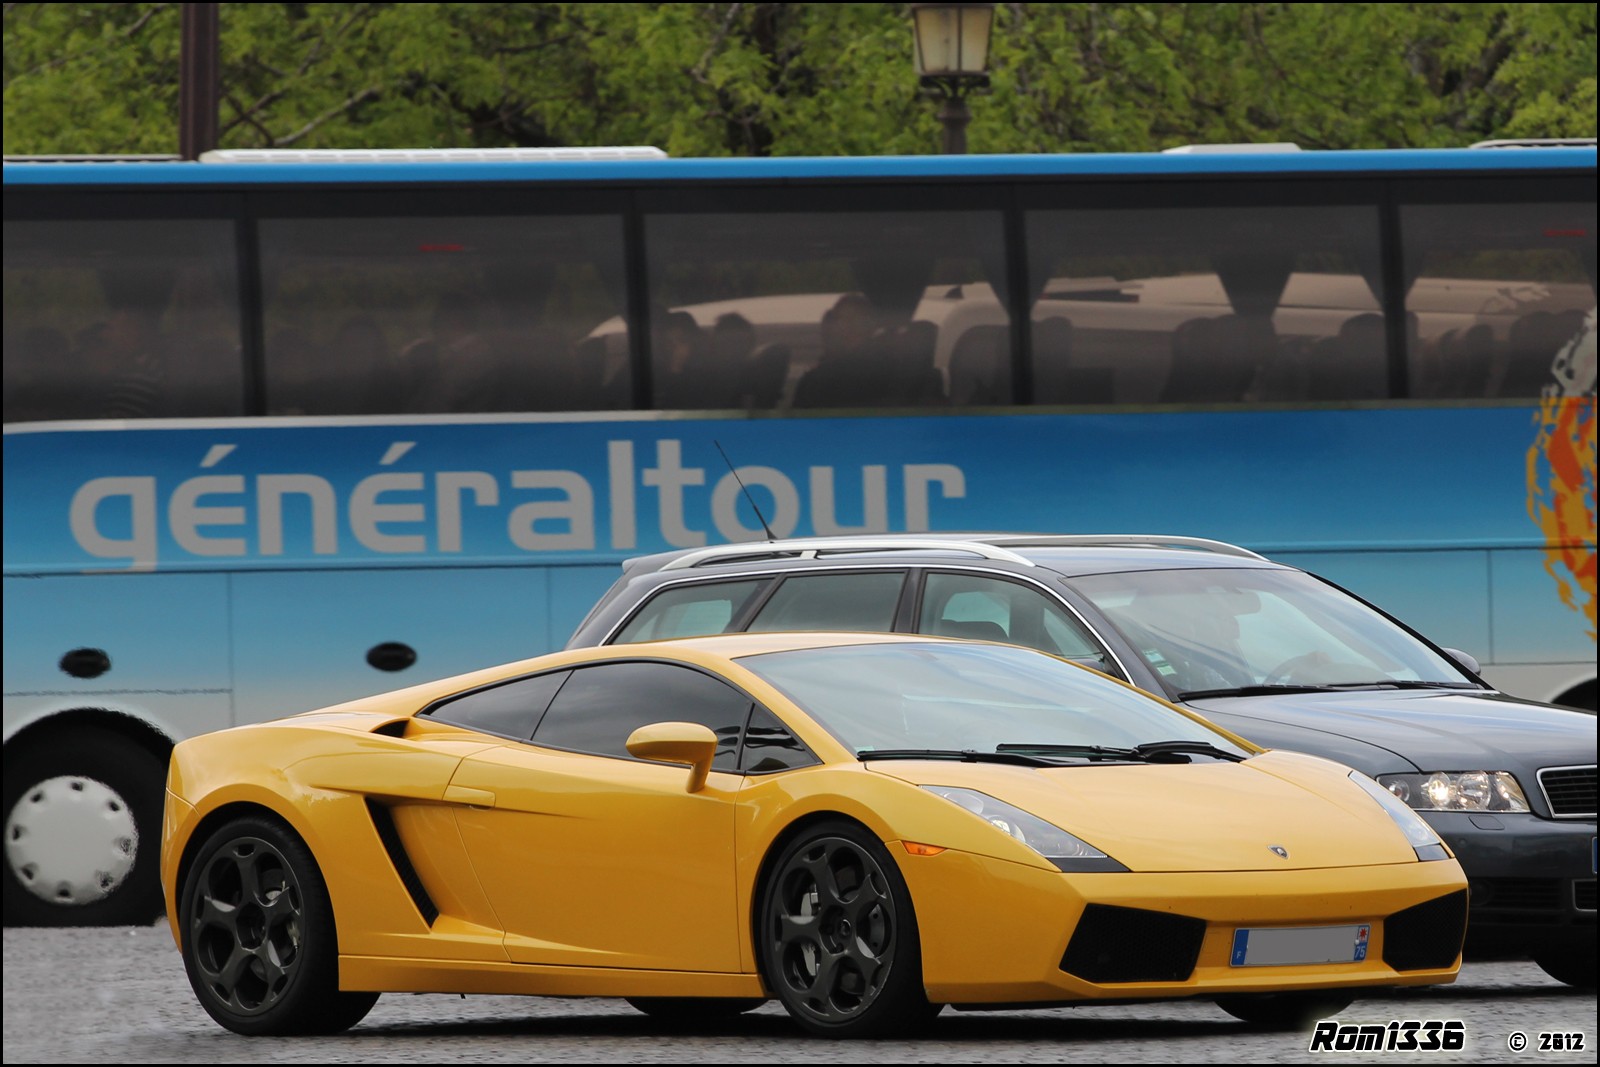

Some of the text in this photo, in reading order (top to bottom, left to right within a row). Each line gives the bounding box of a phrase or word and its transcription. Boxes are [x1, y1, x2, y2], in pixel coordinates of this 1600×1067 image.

[69, 439, 966, 572] généraltour
[1236, 951, 1242, 959] F
[1354, 945, 1366, 959] 75
